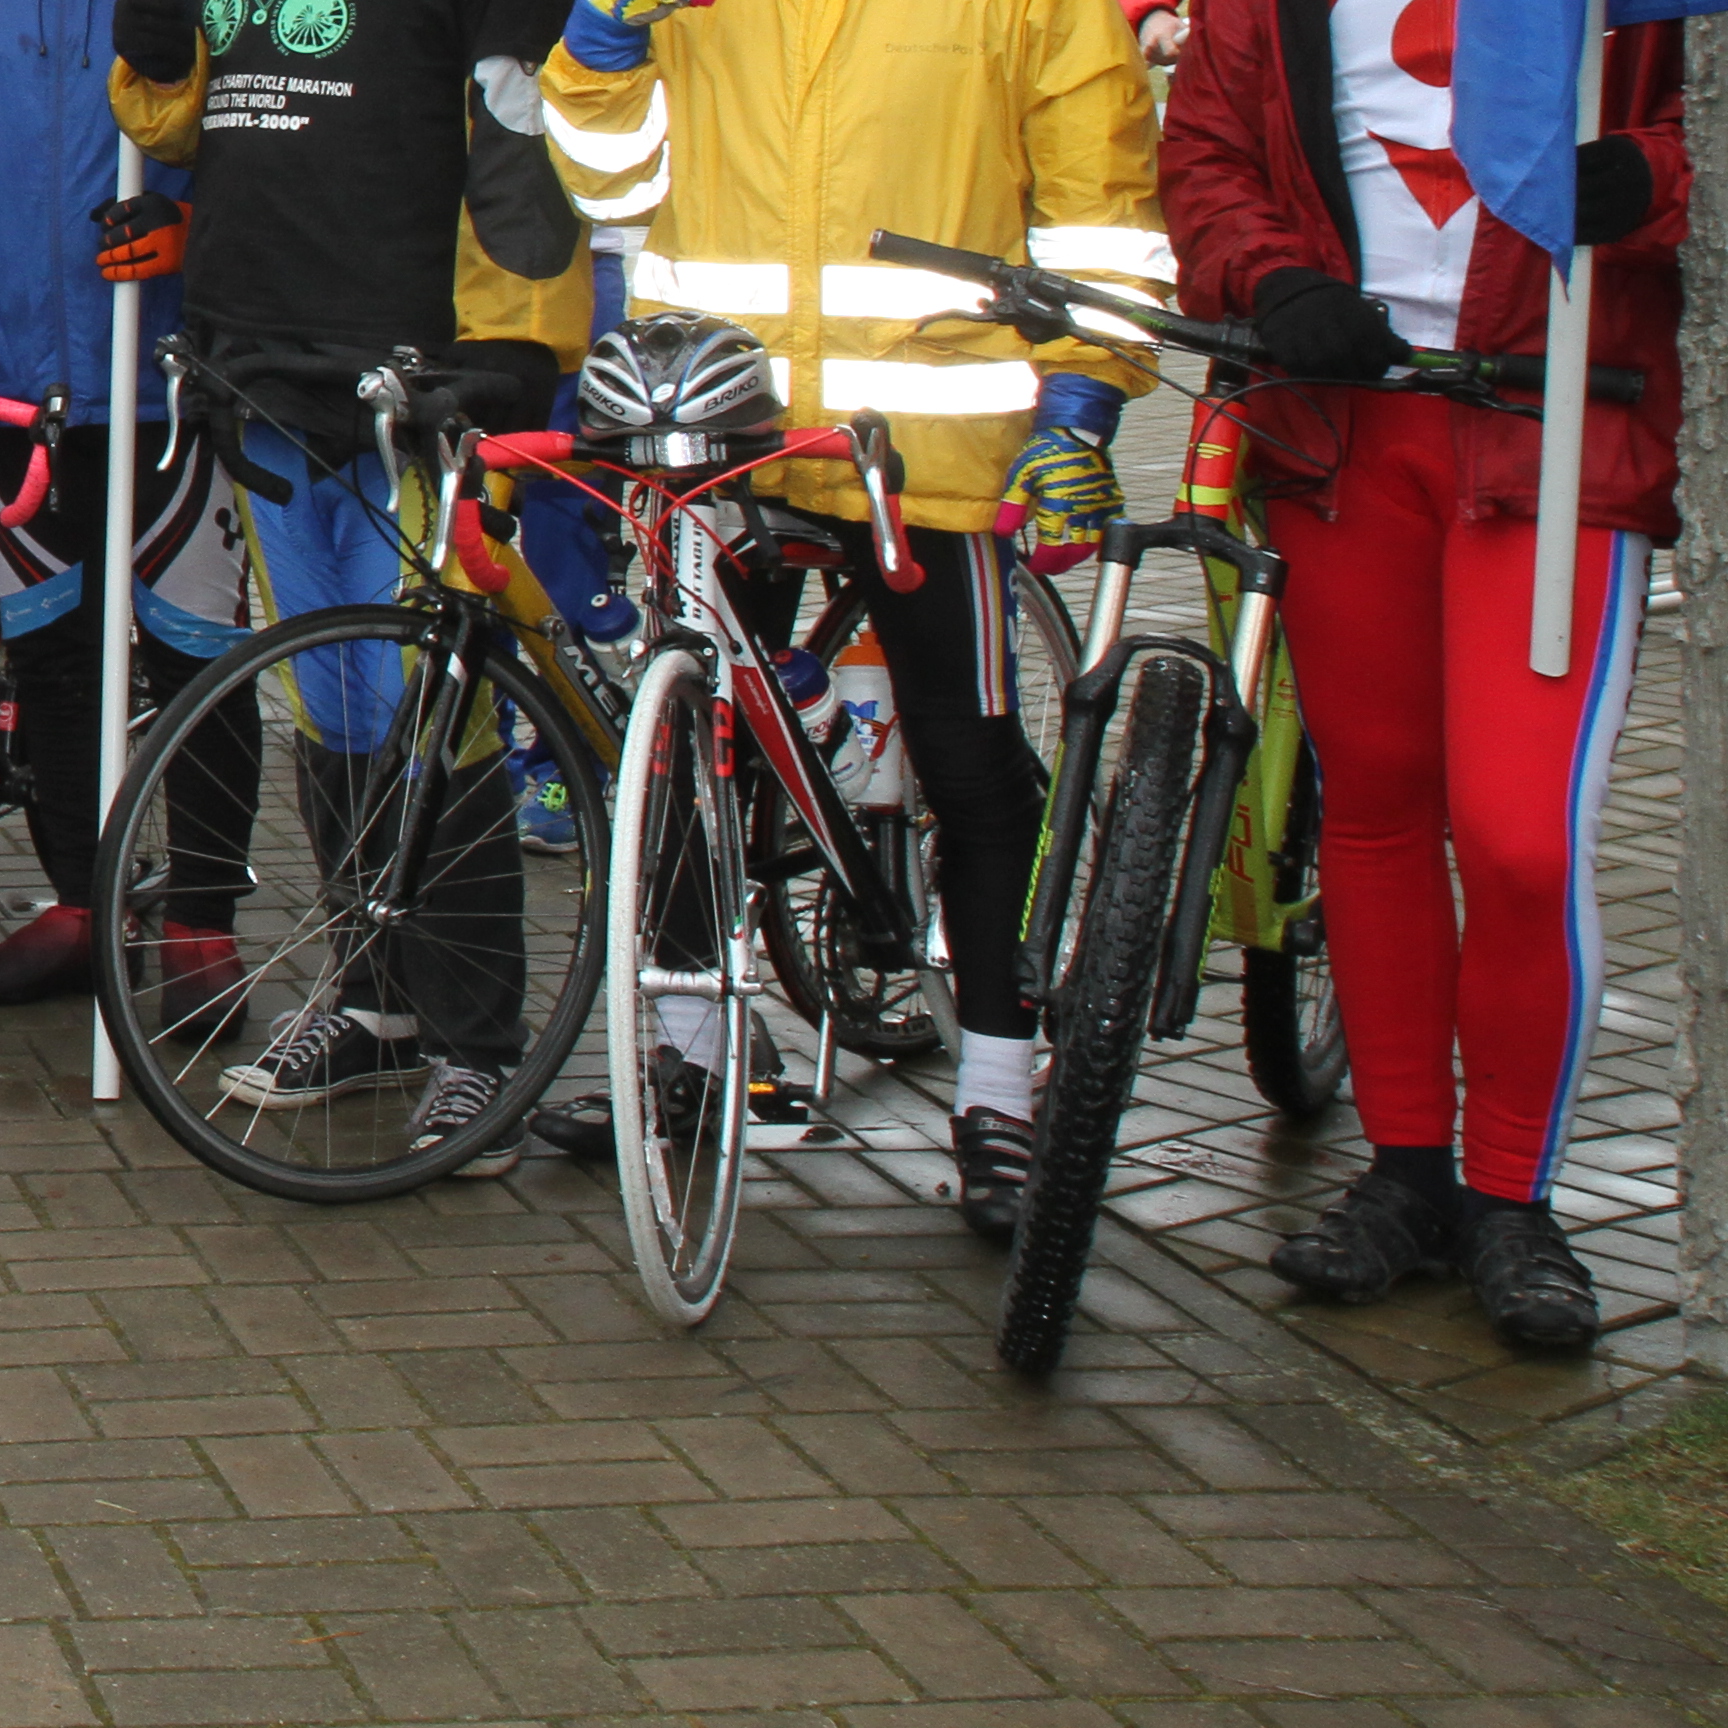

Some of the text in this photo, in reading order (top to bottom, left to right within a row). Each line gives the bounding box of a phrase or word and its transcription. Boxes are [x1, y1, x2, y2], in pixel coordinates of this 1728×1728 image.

[254, 73, 287, 91] CYCLE
[286, 76, 355, 97] MARATHON
[230, 93, 248, 108] THE
[248, 93, 287, 110] WORLD
[582, 380, 626, 416] BRIKO
[702, 376, 759, 413] BRIKO
